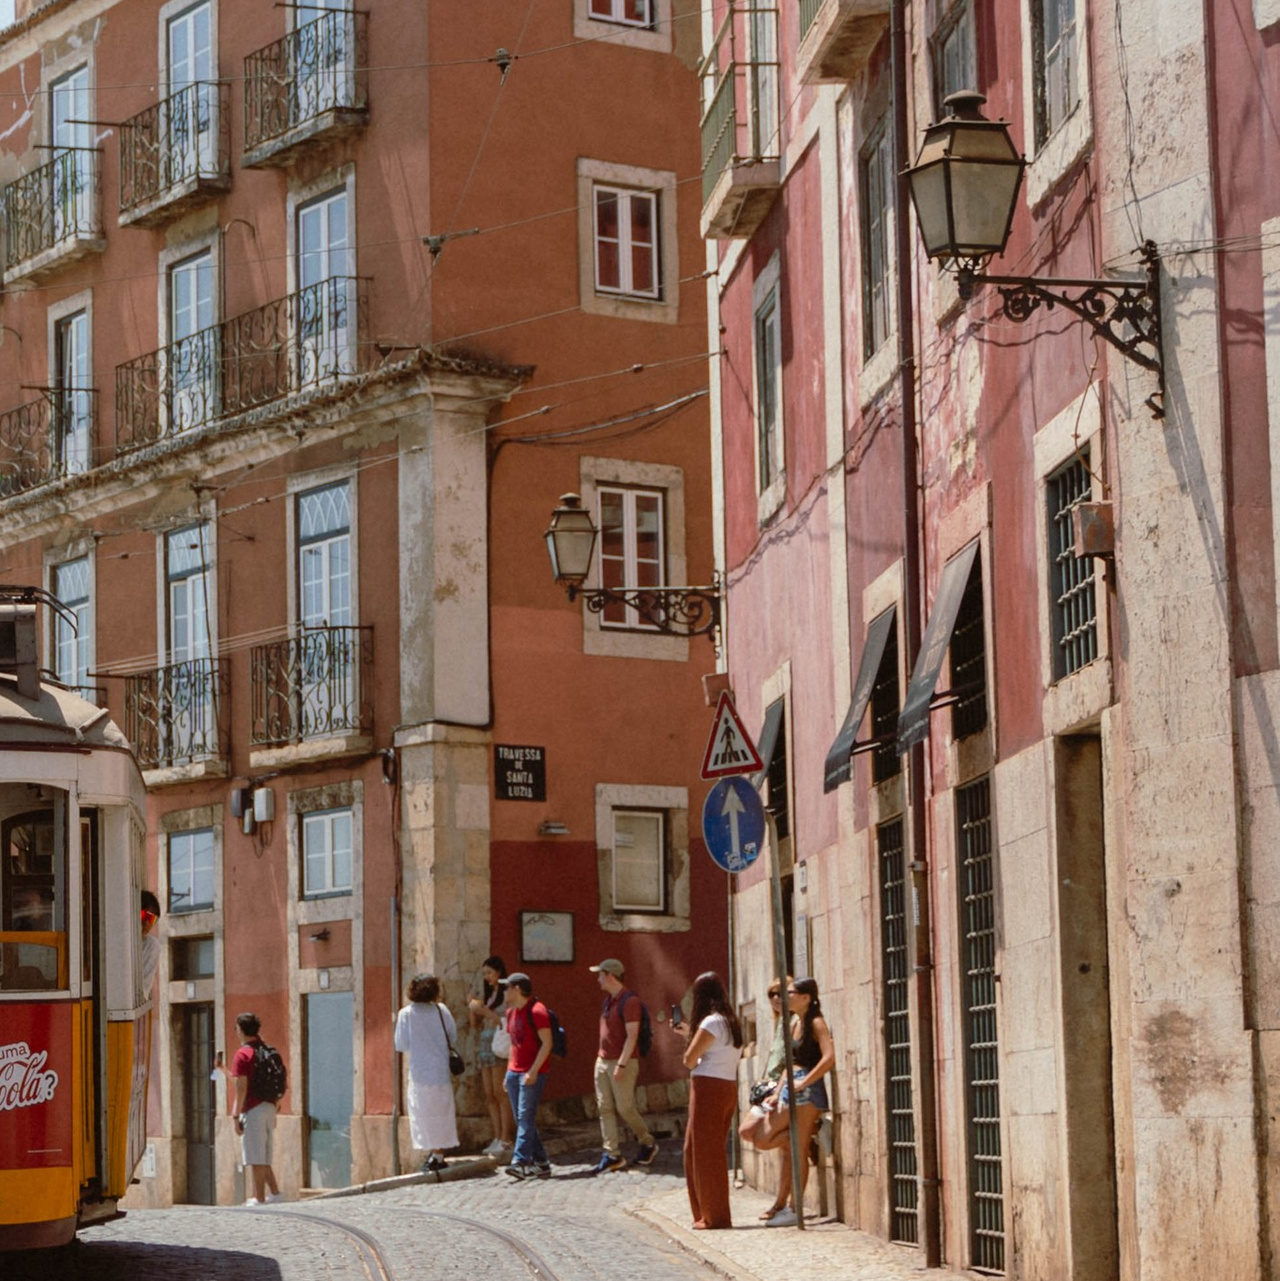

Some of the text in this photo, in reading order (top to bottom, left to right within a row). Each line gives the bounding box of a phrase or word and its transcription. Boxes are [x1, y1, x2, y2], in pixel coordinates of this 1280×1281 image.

[498, 747, 541, 761] TRAVESSA
[514, 761, 523, 770] DE
[506, 771, 533, 784] SANTA
[508, 786, 533, 798] LUZIA
